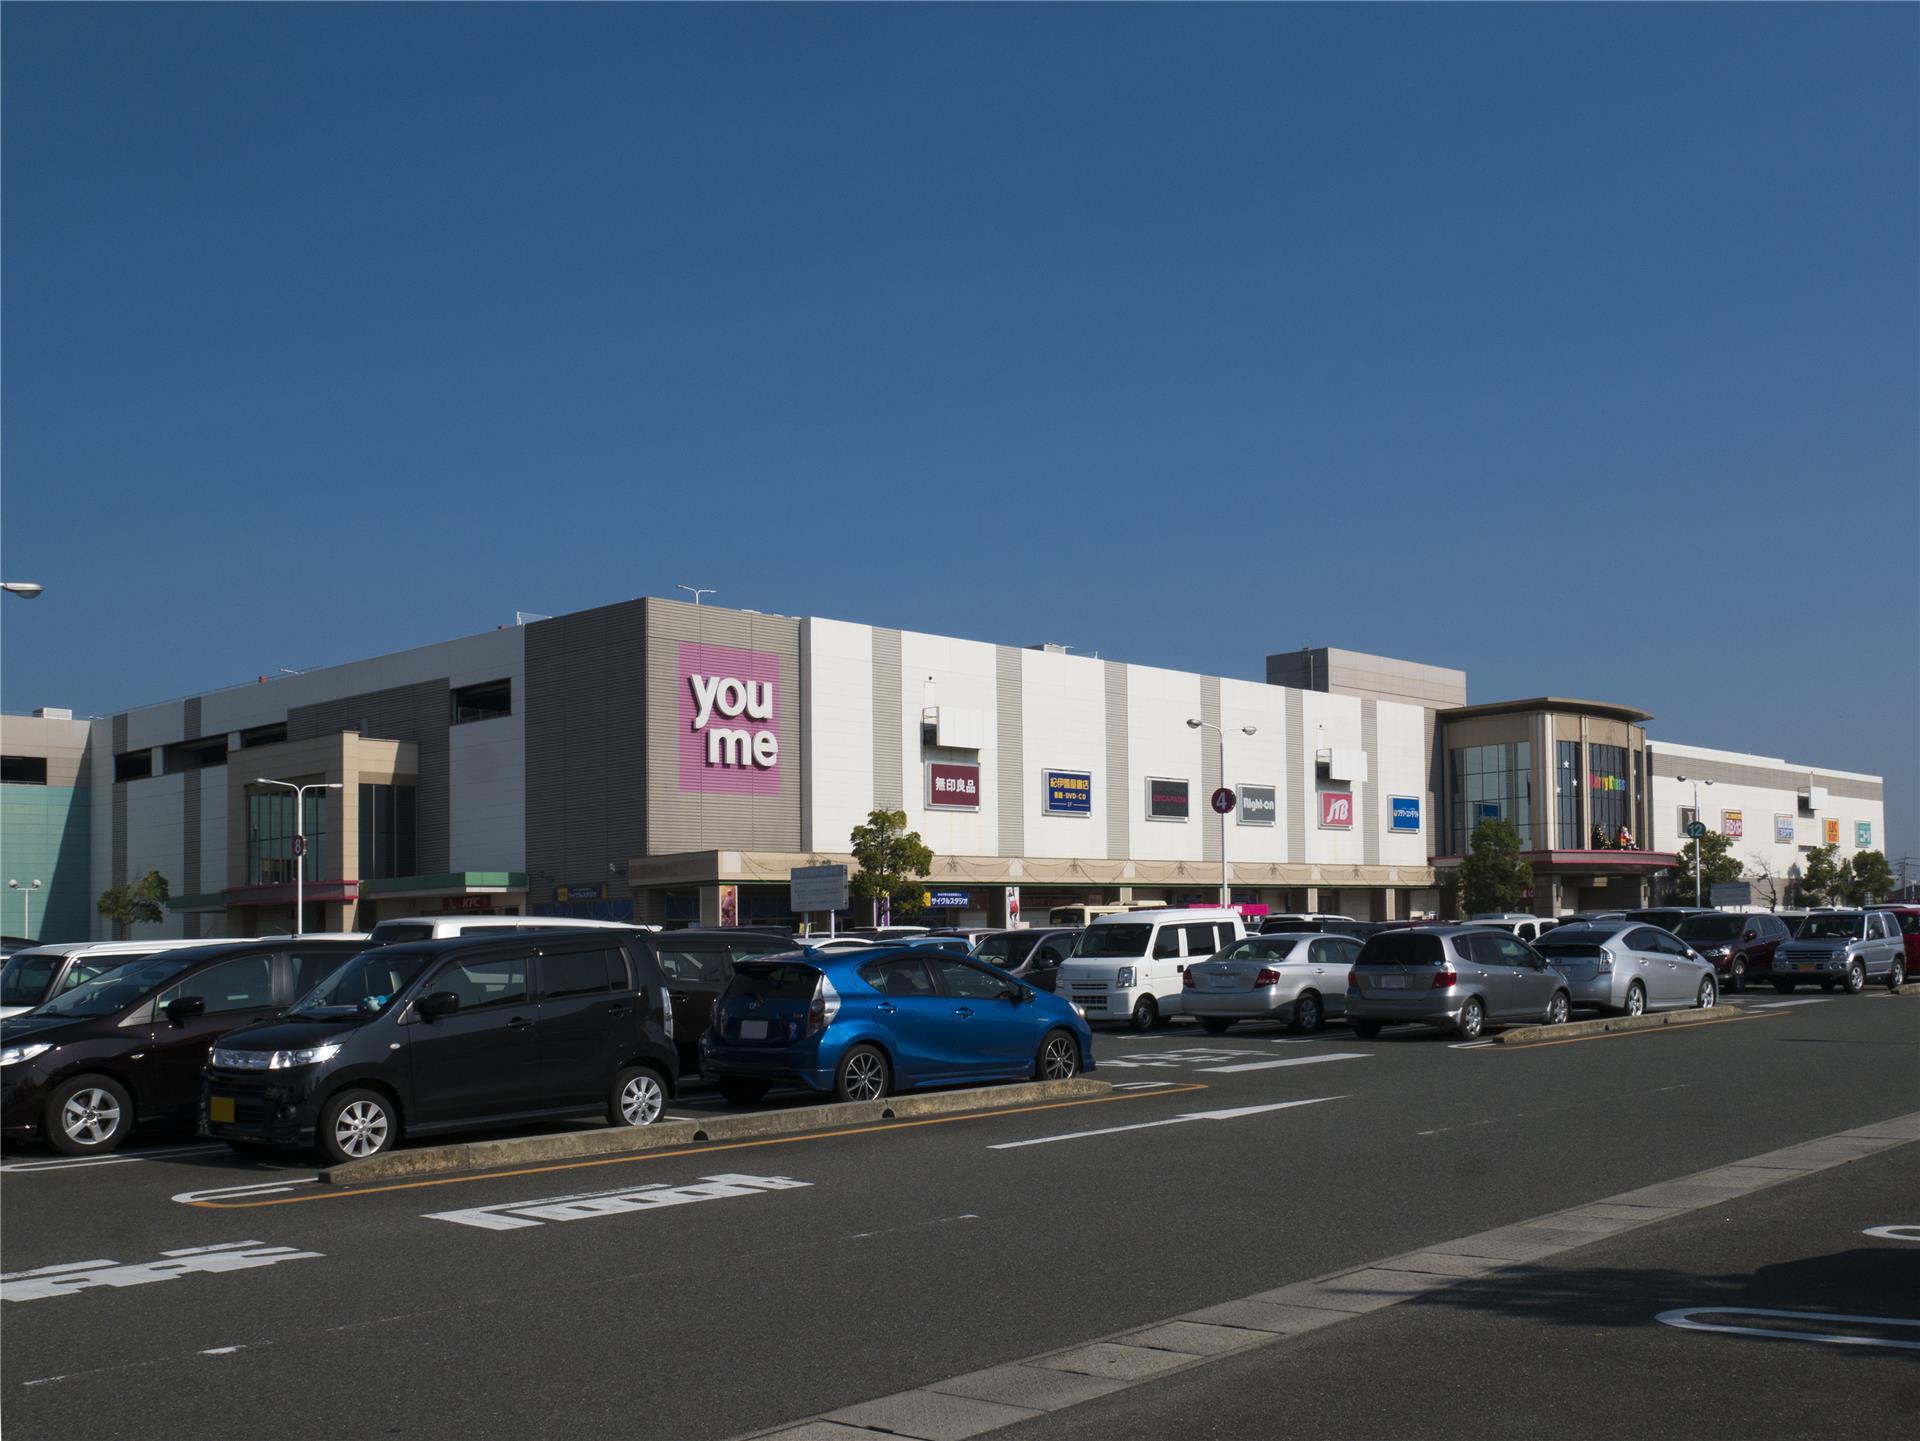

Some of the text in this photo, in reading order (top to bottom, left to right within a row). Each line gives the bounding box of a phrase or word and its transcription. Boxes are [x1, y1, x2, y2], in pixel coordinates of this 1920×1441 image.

[691, 674, 773, 729] you
[709, 728, 779, 767] me
[935, 776, 976, 794] 無印良品
[1216, 791, 1228, 810] 4
[1243, 797, 1275, 812] Right-on
[1688, 823, 1704, 837] 12
[295, 838, 302, 854] 8
[931, 897, 968, 905] サイクルスタジオ
